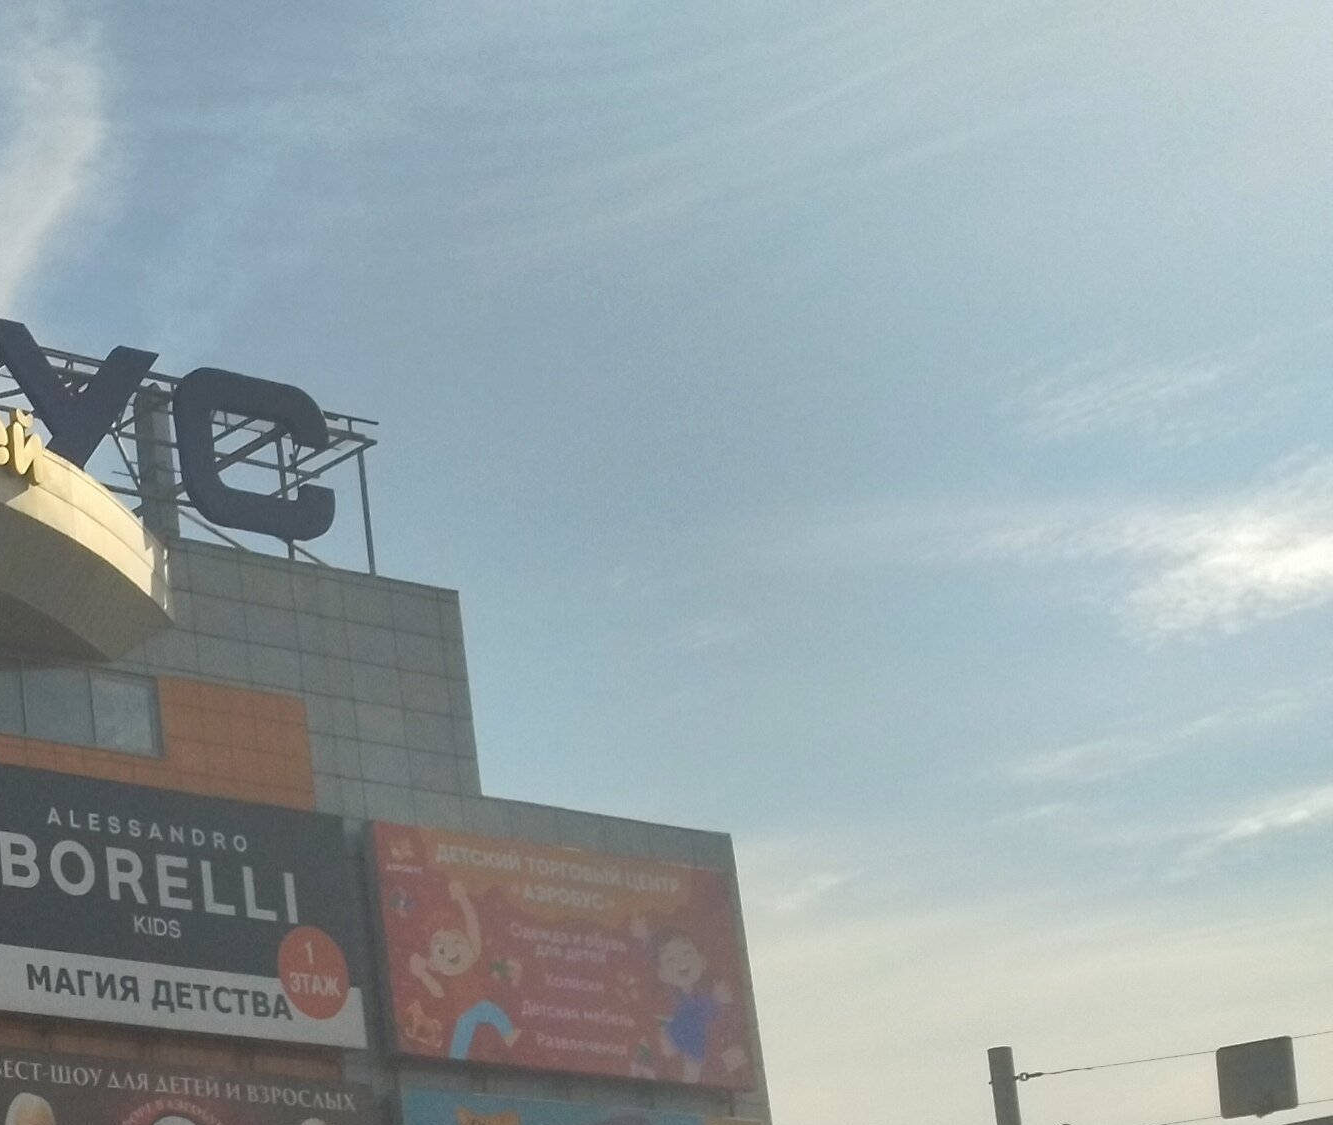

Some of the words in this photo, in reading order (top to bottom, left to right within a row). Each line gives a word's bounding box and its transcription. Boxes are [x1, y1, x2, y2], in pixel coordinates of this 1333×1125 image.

[47, 807, 249, 853] ALESSANDRO
[436, 844, 521, 871] ДЕТСКИЙ
[525, 857, 622, 886] ТОРГОВЫЙ
[625, 870, 680, 894] ЦЕНТР
[133, 914, 182, 939] KIDS
[26, 963, 139, 1003] МАГИЯ
[151, 978, 293, 1021] ДЕТСТВА
[290, 974, 341, 998] ЭТАЖ
[107, 1072, 148, 1092] ДЛЯ
[154, 1075, 220, 1099] ДЕТЕЙ
[225, 1083, 241, 1101] И
[247, 1084, 357, 1112] ВЗРОСЛЫХ
